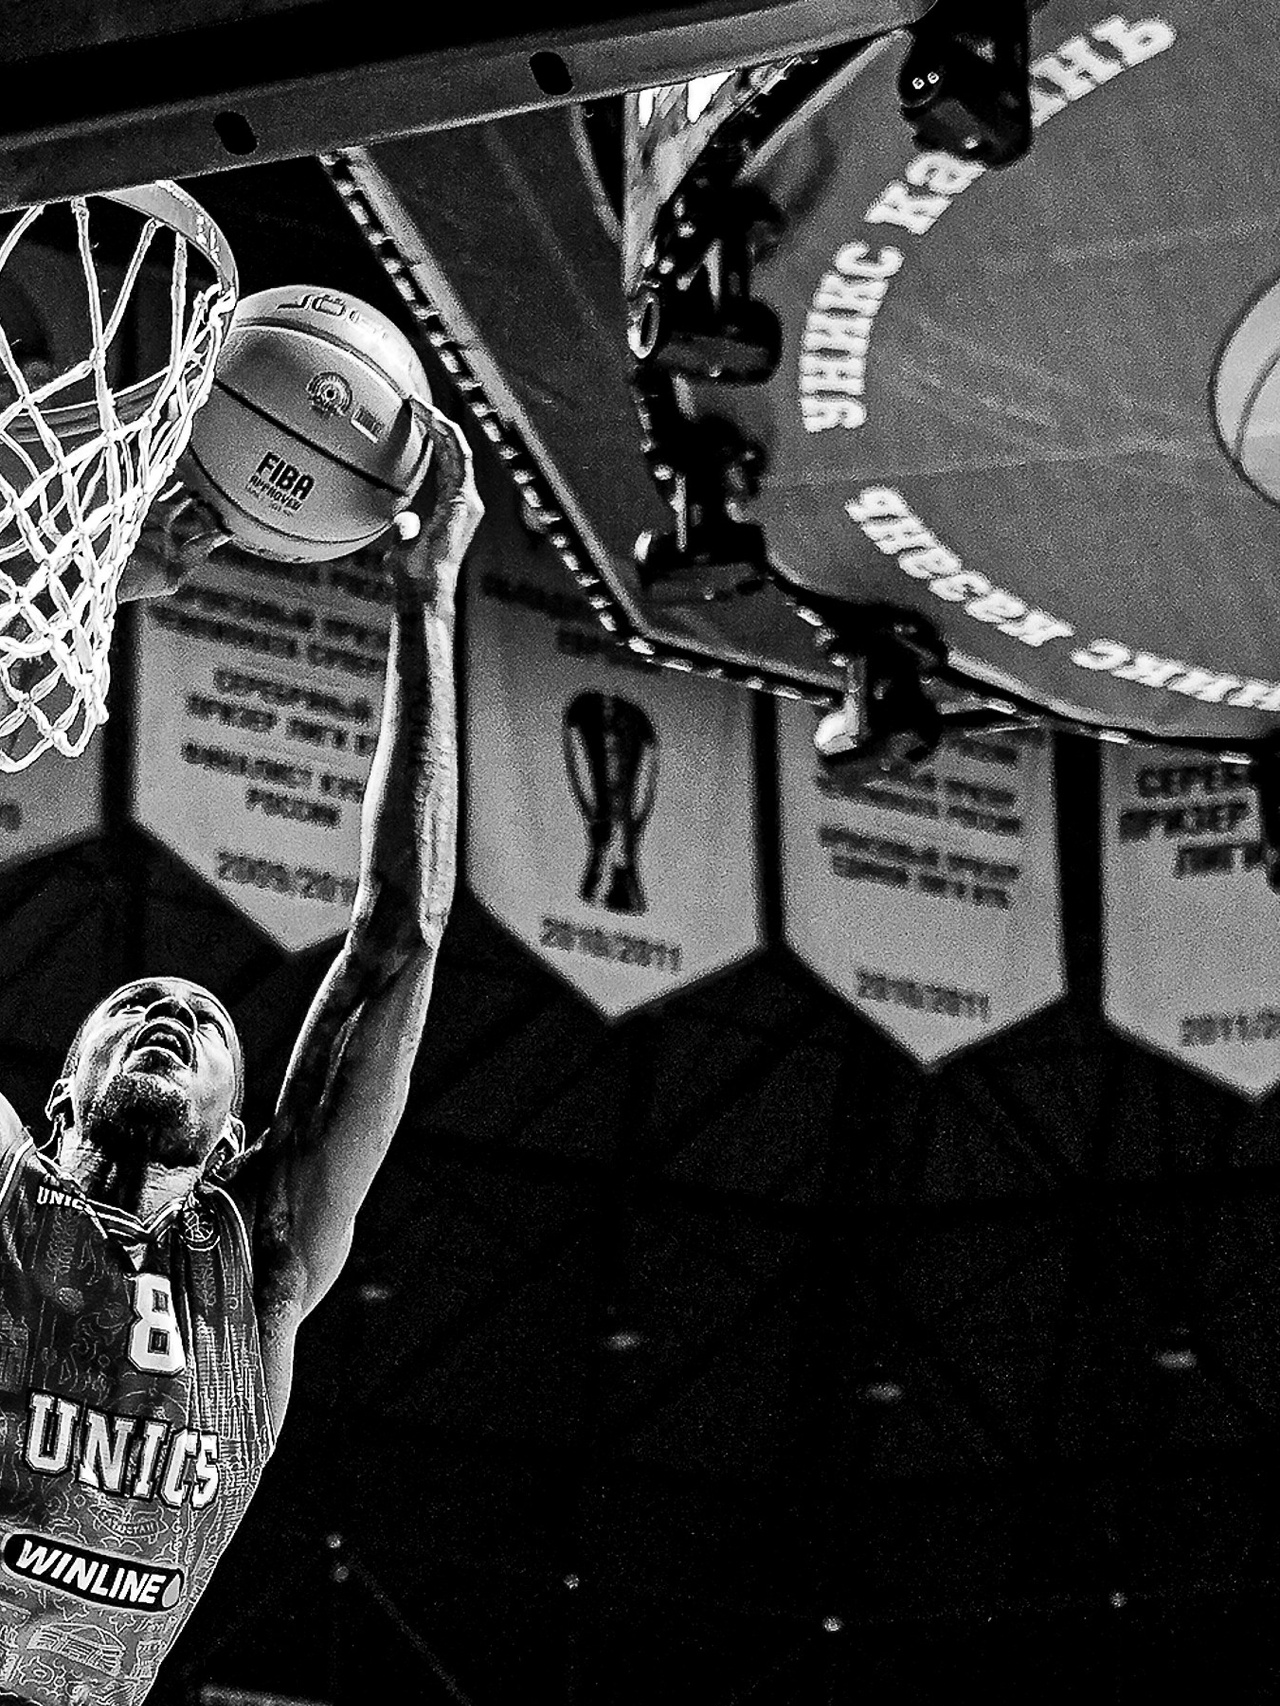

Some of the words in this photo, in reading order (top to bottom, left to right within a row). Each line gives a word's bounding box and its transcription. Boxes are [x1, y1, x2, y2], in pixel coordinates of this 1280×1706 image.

[799, 241, 904, 432] УНИКС
[865, 17, 1176, 235] Кань
[256, 451, 315, 501] FIBA
[218, 852, 359, 905] 2009/201
[36, 1186, 86, 1211] UNIC
[128, 1272, 187, 1374] 8
[25, 1391, 220, 1511] UNICS
[15, 1538, 168, 1605] WINLINE
